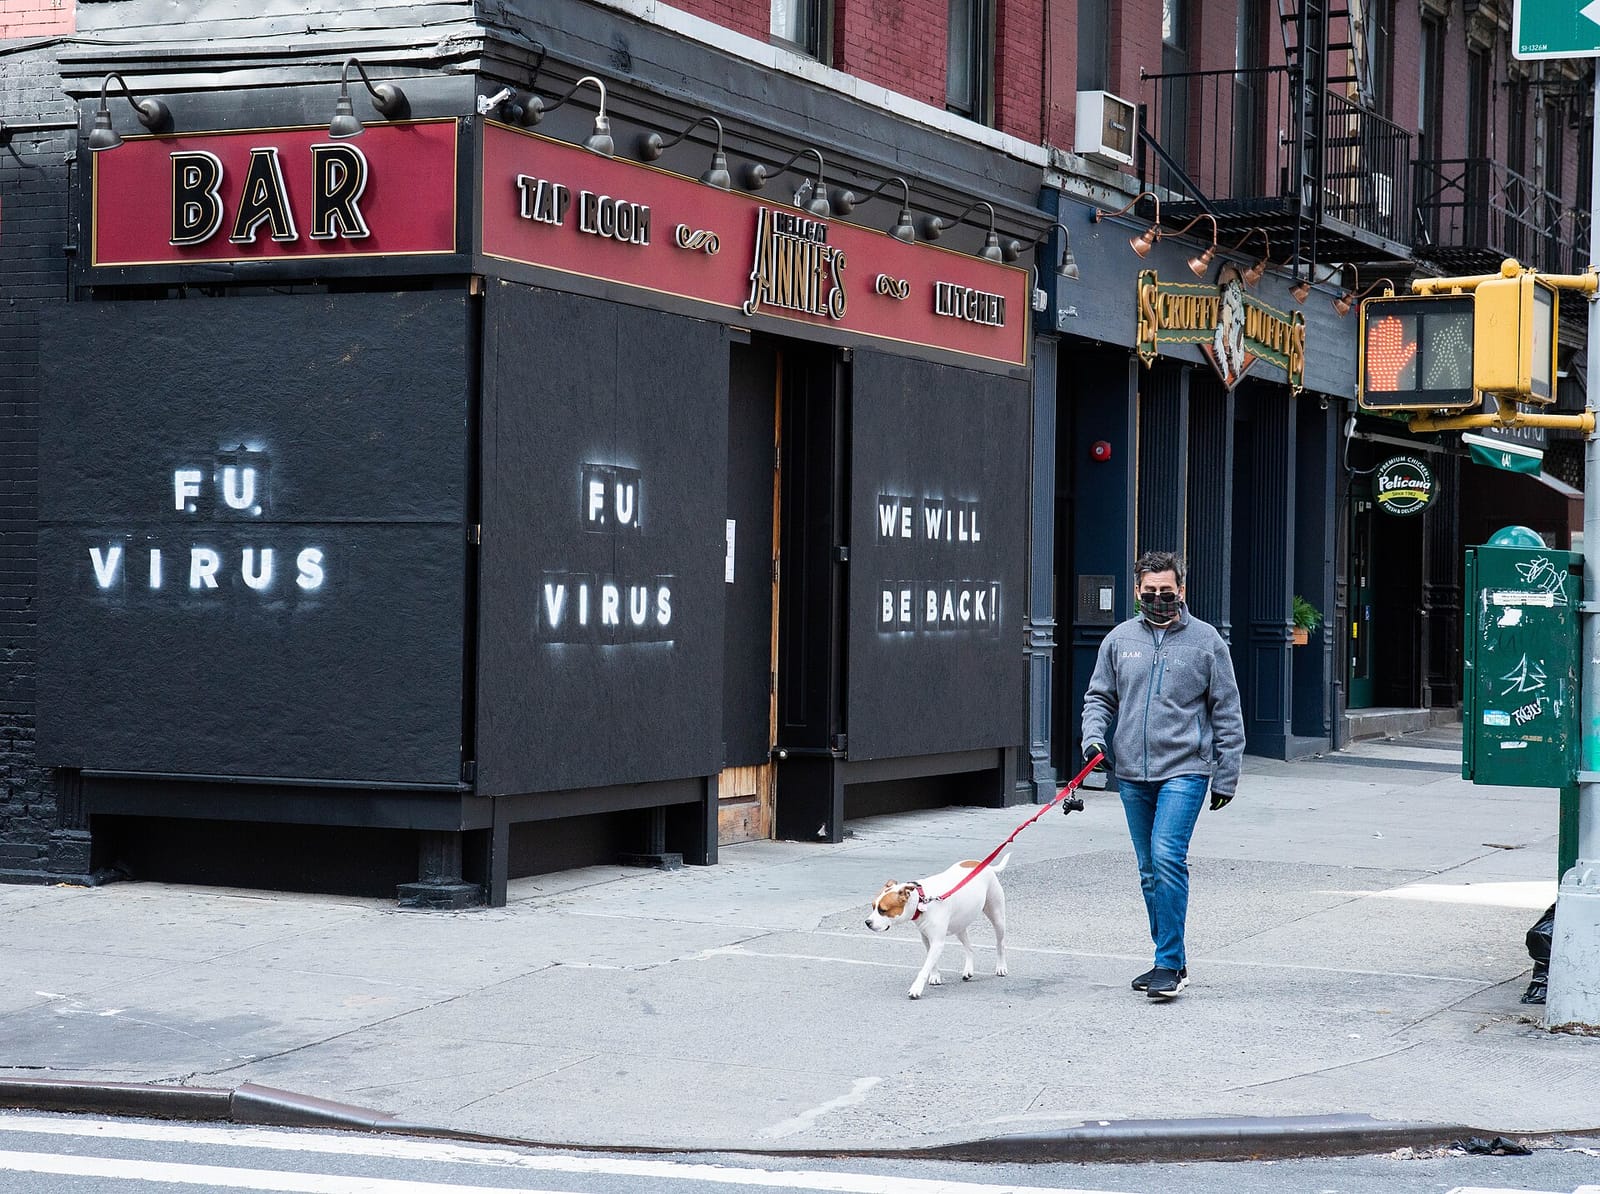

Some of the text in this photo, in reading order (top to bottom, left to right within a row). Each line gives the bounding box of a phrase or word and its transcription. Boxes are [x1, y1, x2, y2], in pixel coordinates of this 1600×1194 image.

[169, 142, 370, 246] BAR
[517, 174, 650, 246] TAP ROOM
[773, 211, 829, 245] HELLCAT
[743, 207, 847, 320] ANNIE'S
[936, 281, 1006, 327] KITCHEN
[1142, 284, 1221, 342] SCRUFFY
[1379, 475, 1431, 491] Pelicana
[1380, 456, 1429, 476] PREMIUM CHICKEN
[174, 467, 263, 517] F.U.
[589, 477, 638, 529] F.U.
[880, 504, 981, 543] WE WILL
[89, 547, 325, 590] VIRUS
[544, 584, 672, 629] VIRUS
[883, 586, 996, 622] BE BACK!
